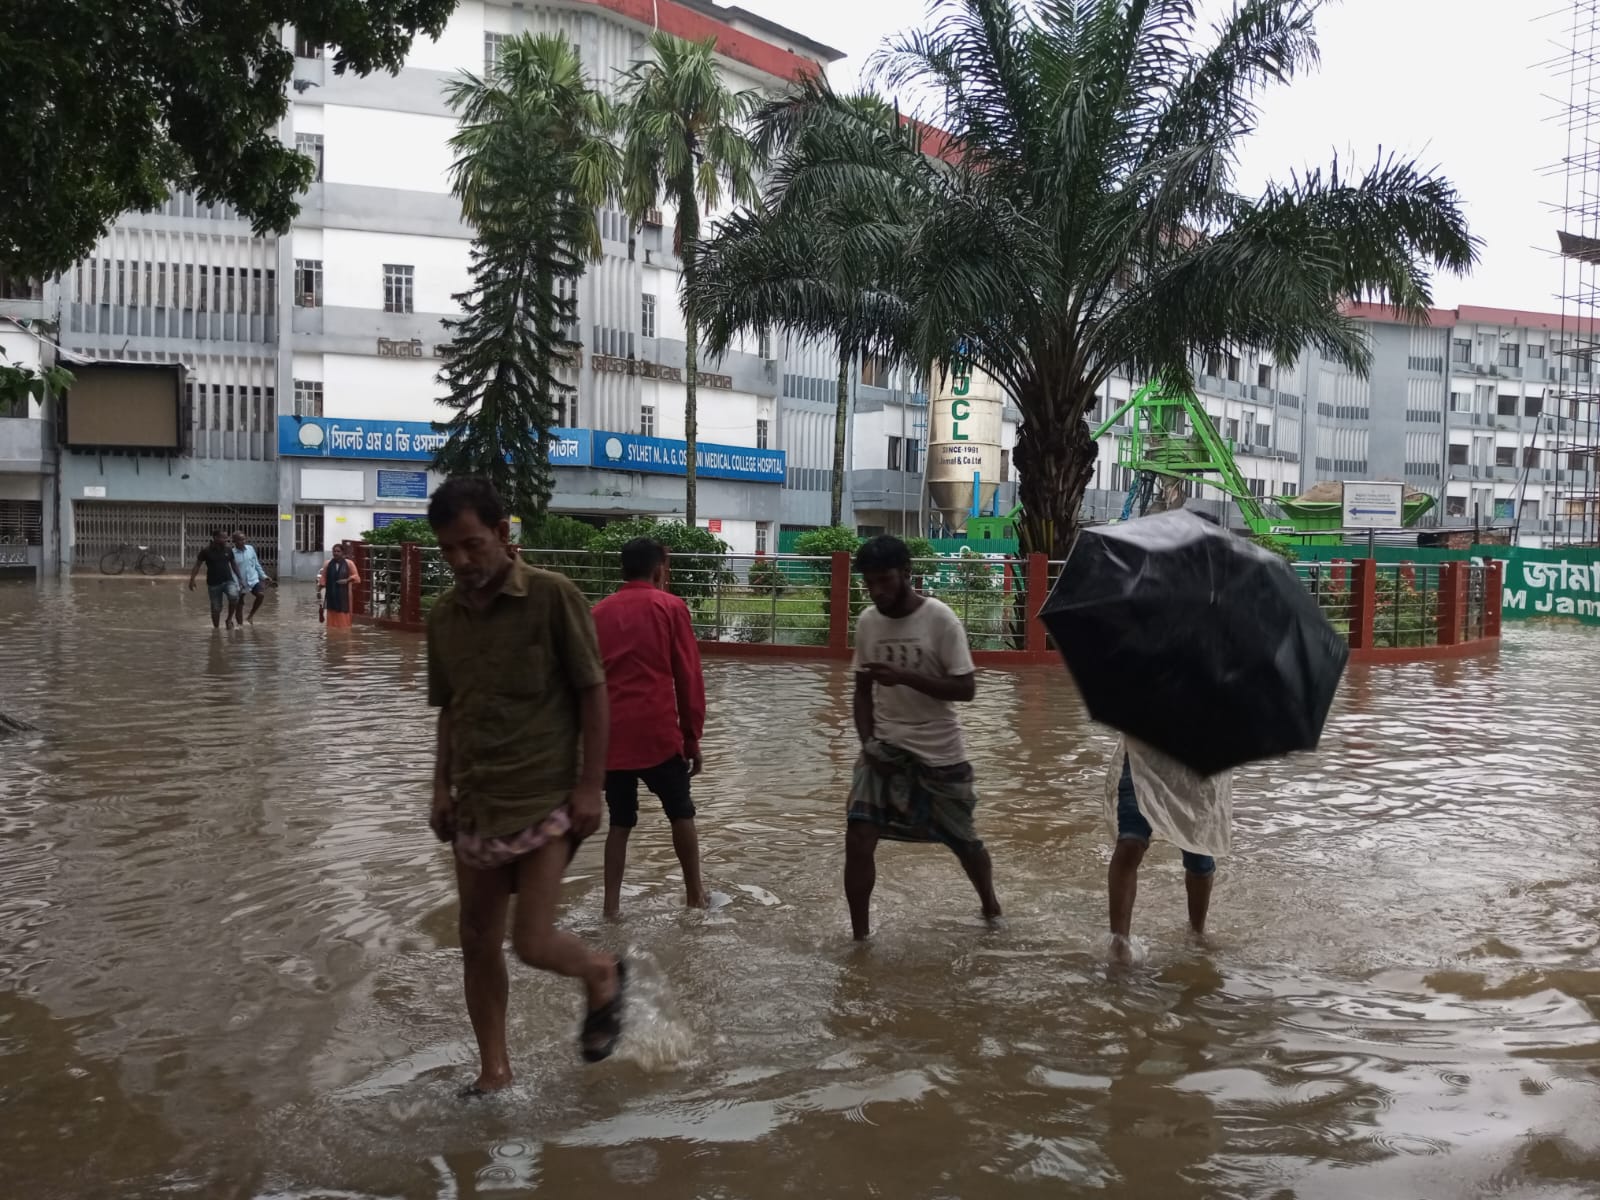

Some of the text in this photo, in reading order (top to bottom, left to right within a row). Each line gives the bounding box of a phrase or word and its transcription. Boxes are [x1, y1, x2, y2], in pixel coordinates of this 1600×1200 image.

[331, 425, 364, 451] সিলেট
[366, 432, 382, 452] এম
[385, 433, 393, 452] এ
[395, 428, 411, 452] জি
[628, 443, 652, 463] SYLHET
[678, 449, 704, 468] OSNI
[704, 451, 731, 470] MEDICAL
[731, 454, 757, 472] COLLEGE
[757, 456, 783, 474] HOSPITAL
